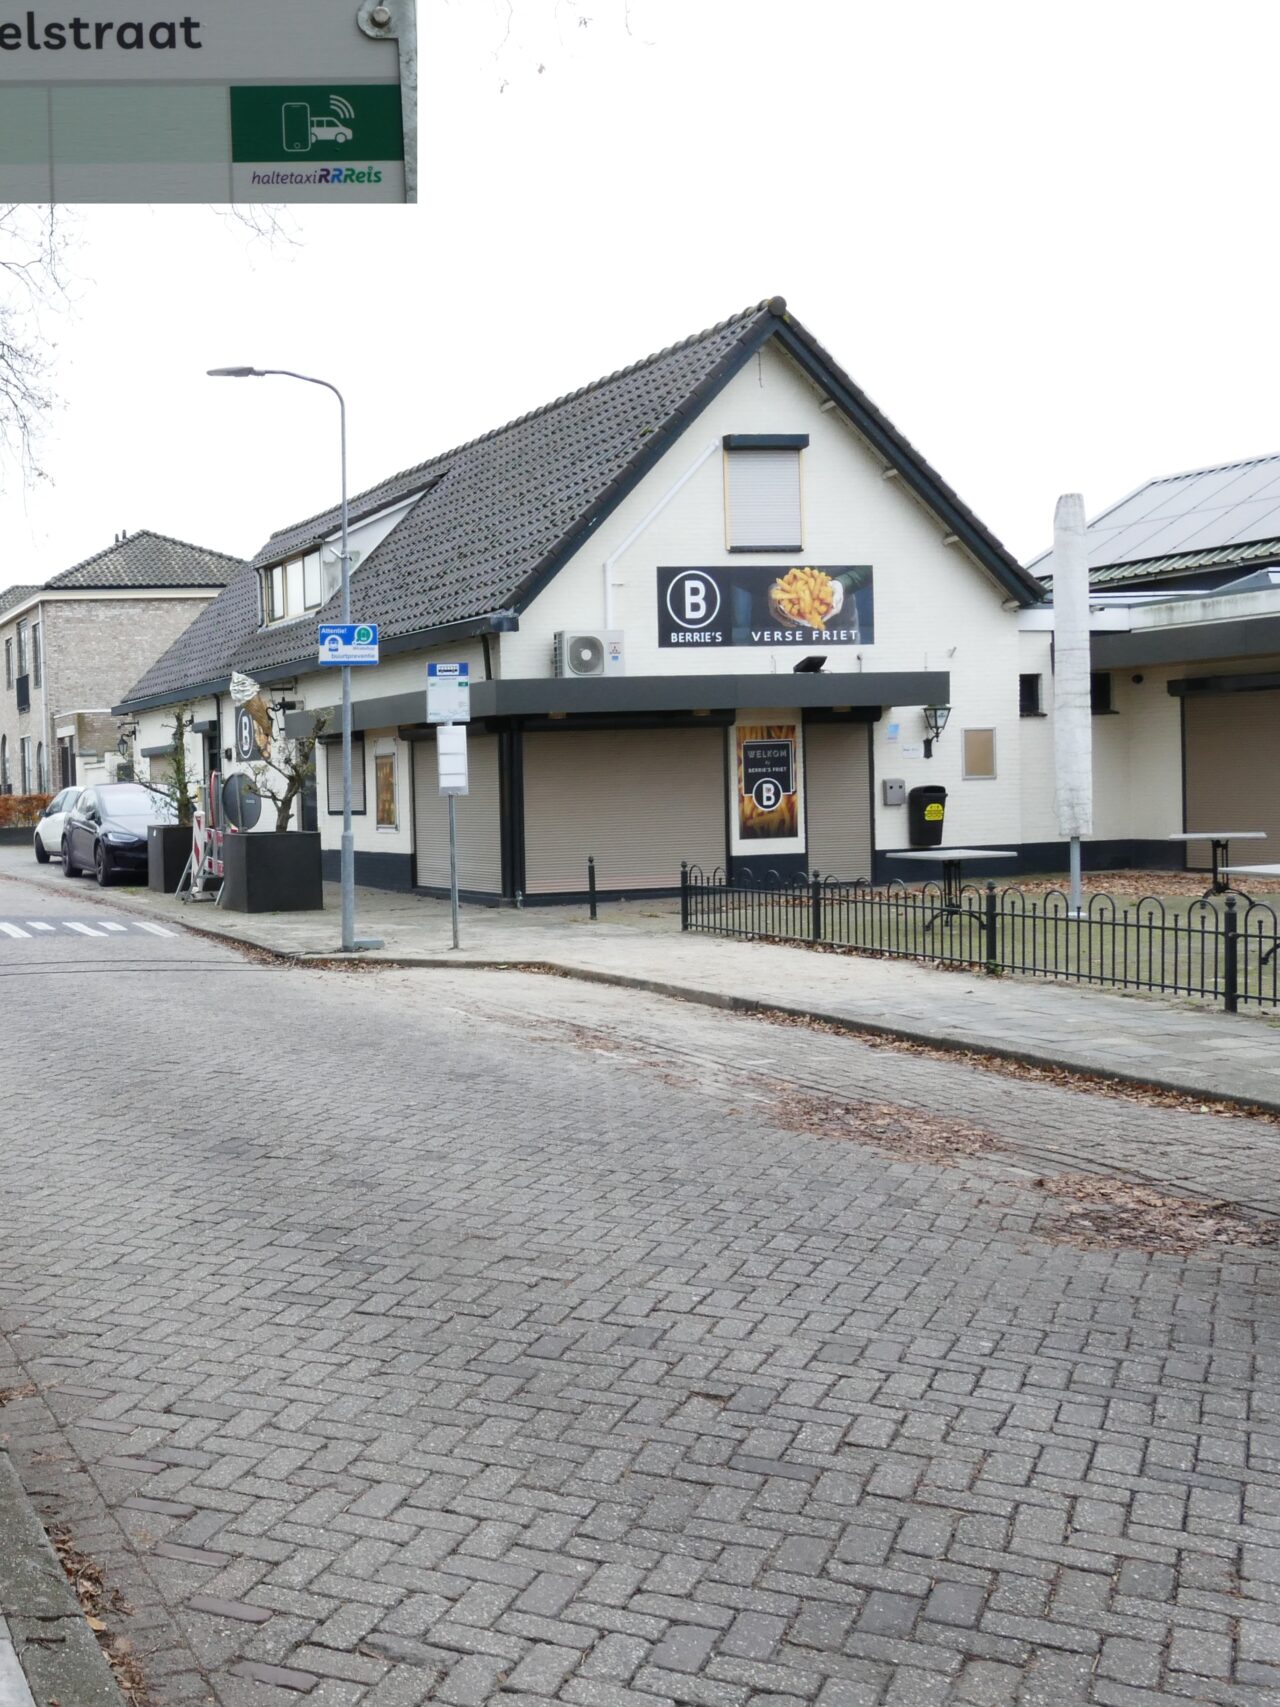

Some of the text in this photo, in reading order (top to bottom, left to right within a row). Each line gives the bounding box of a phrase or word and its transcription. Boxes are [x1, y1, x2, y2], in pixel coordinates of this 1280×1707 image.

[684, 579, 707, 619] B
[670, 631, 722, 643] BERRIE'S
[751, 630, 858, 642] VERSE FRIET
[747, 750, 787, 758] WELKOM
[762, 783, 775, 806] B
